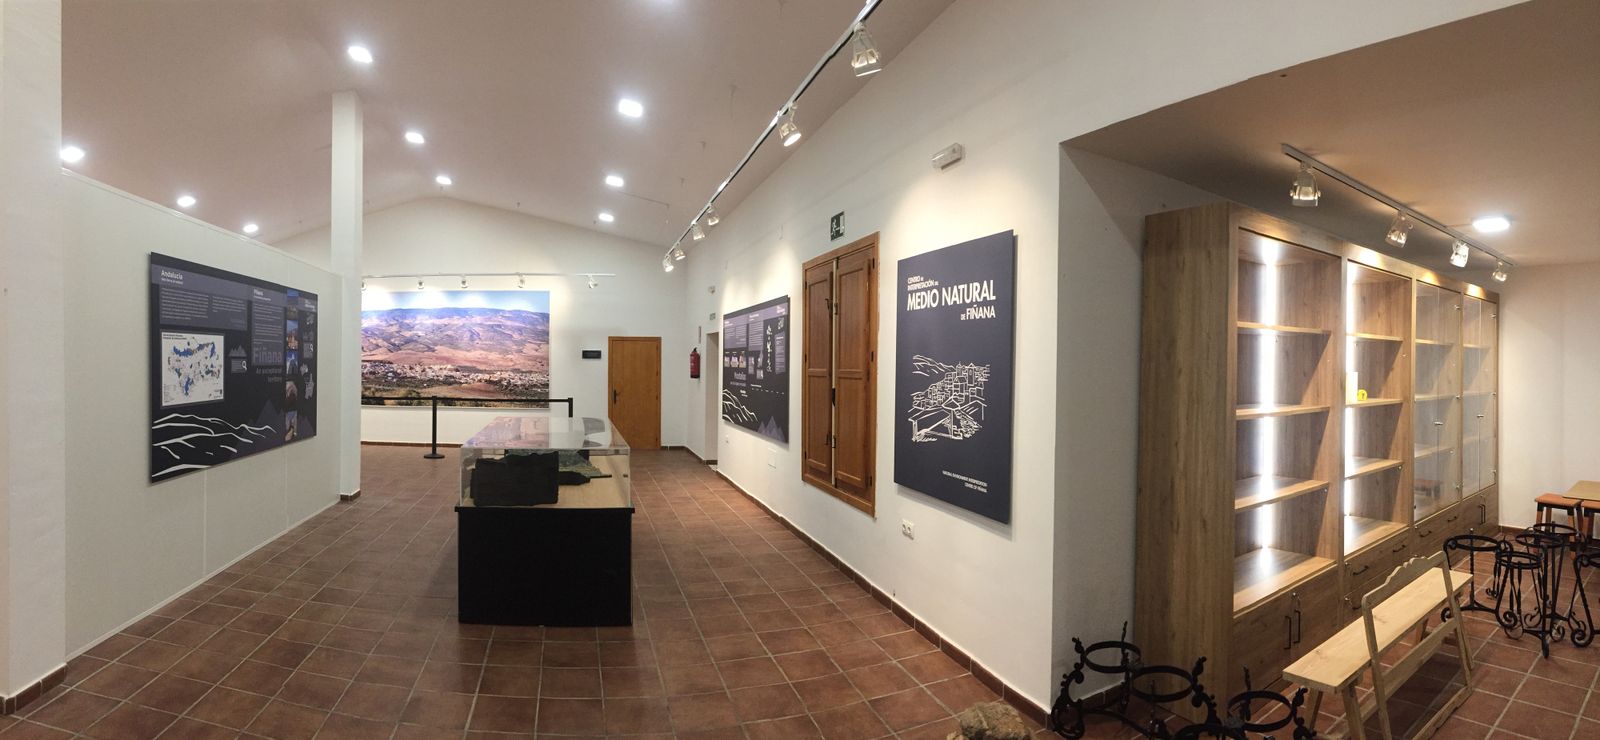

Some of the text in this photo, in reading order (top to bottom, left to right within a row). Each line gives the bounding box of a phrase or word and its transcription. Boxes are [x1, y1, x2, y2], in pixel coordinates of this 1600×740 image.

[907, 279, 996, 311] MEDIO NATURAL
[966, 304, 996, 320] FIÑANA
